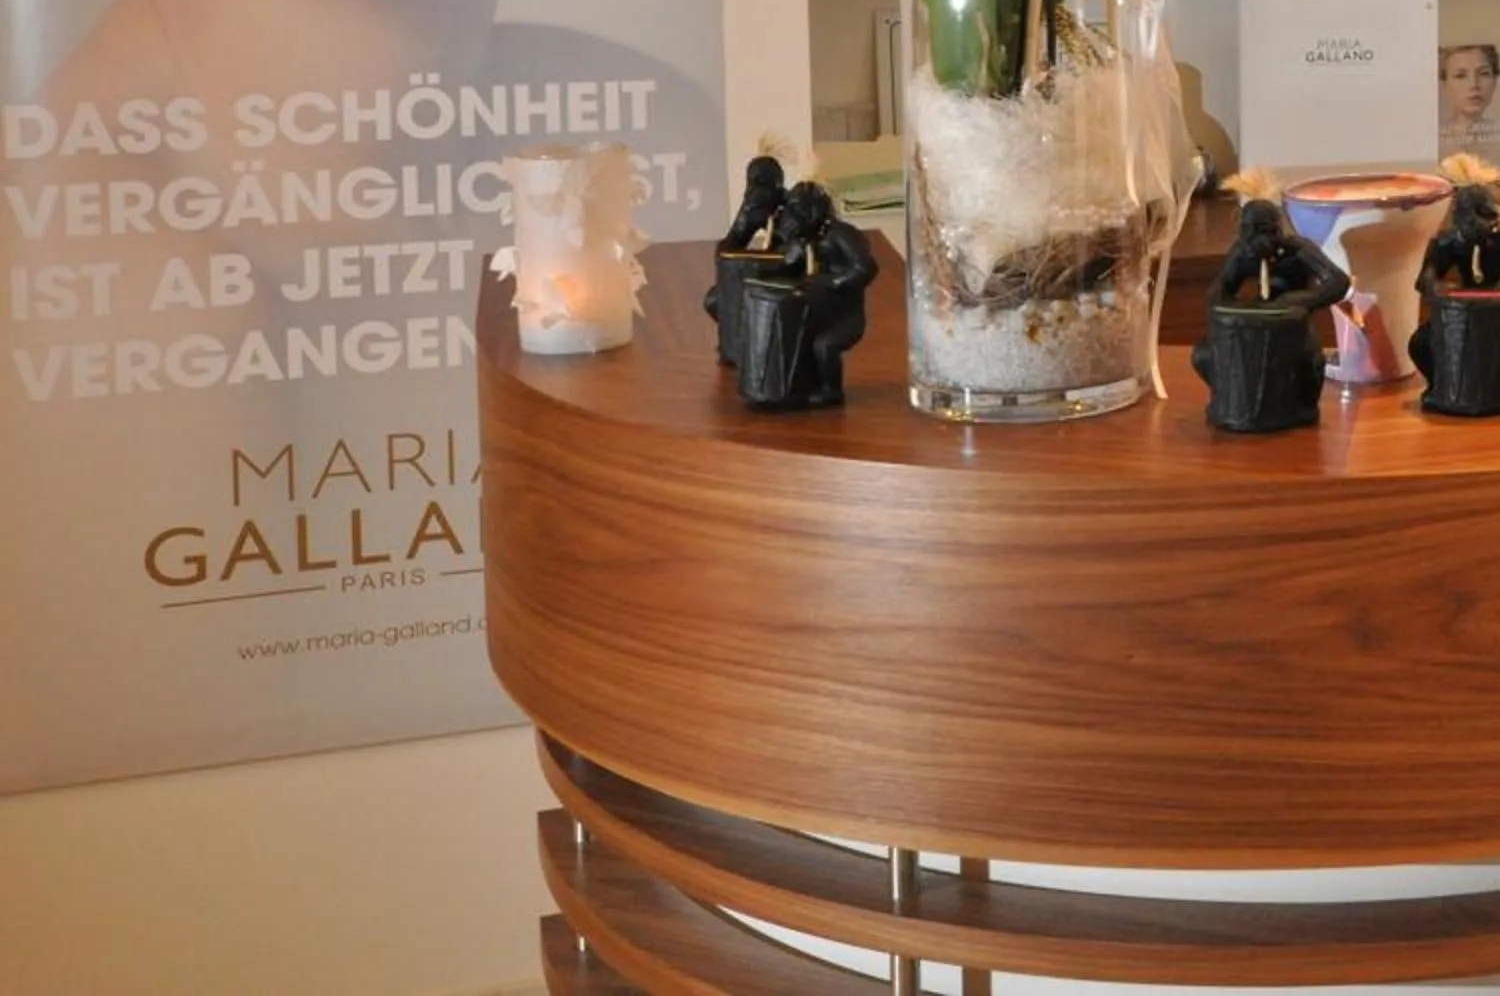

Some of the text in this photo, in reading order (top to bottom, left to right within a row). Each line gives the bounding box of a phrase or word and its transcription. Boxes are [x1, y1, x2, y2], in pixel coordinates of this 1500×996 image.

[3, 73, 656, 160] DASS SCHÖNHEIT
[4, 152, 702, 240] VERGÄNGLIC ST,
[9, 240, 475, 322] IST AB JETZT
[12, 315, 477, 403] VERGANGEN
[231, 428, 484, 507] MARI
[143, 495, 485, 588] GALLA
[340, 568, 427, 593] PARIS
[238, 614, 488, 661] www.maria-galland.c
